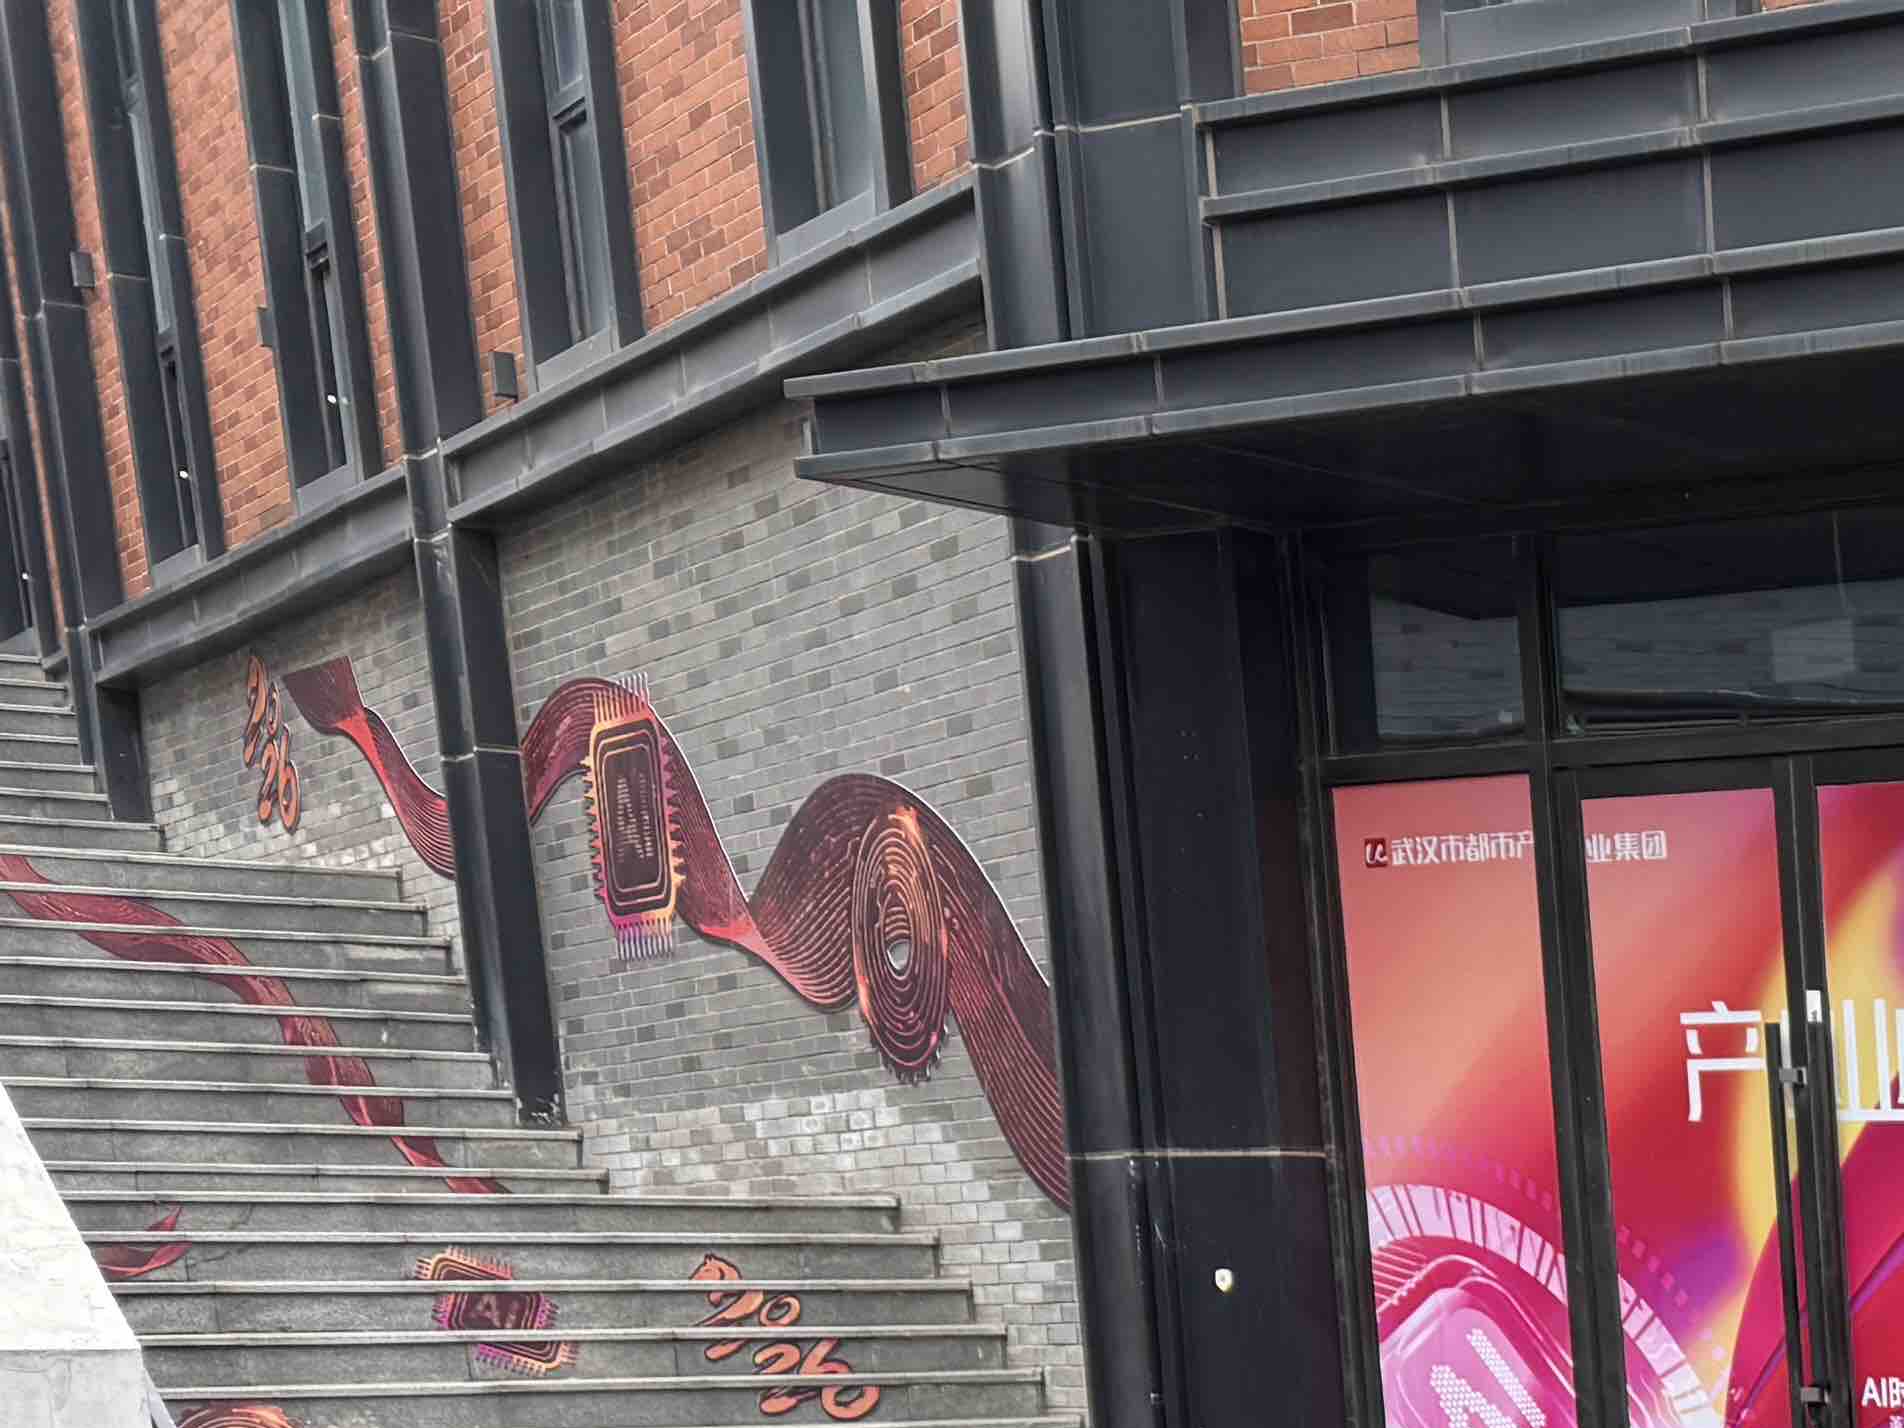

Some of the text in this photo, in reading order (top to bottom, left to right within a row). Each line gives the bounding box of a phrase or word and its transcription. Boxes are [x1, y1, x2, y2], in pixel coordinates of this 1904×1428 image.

[1391, 830, 1667, 866] 武汉市都市产业集团
